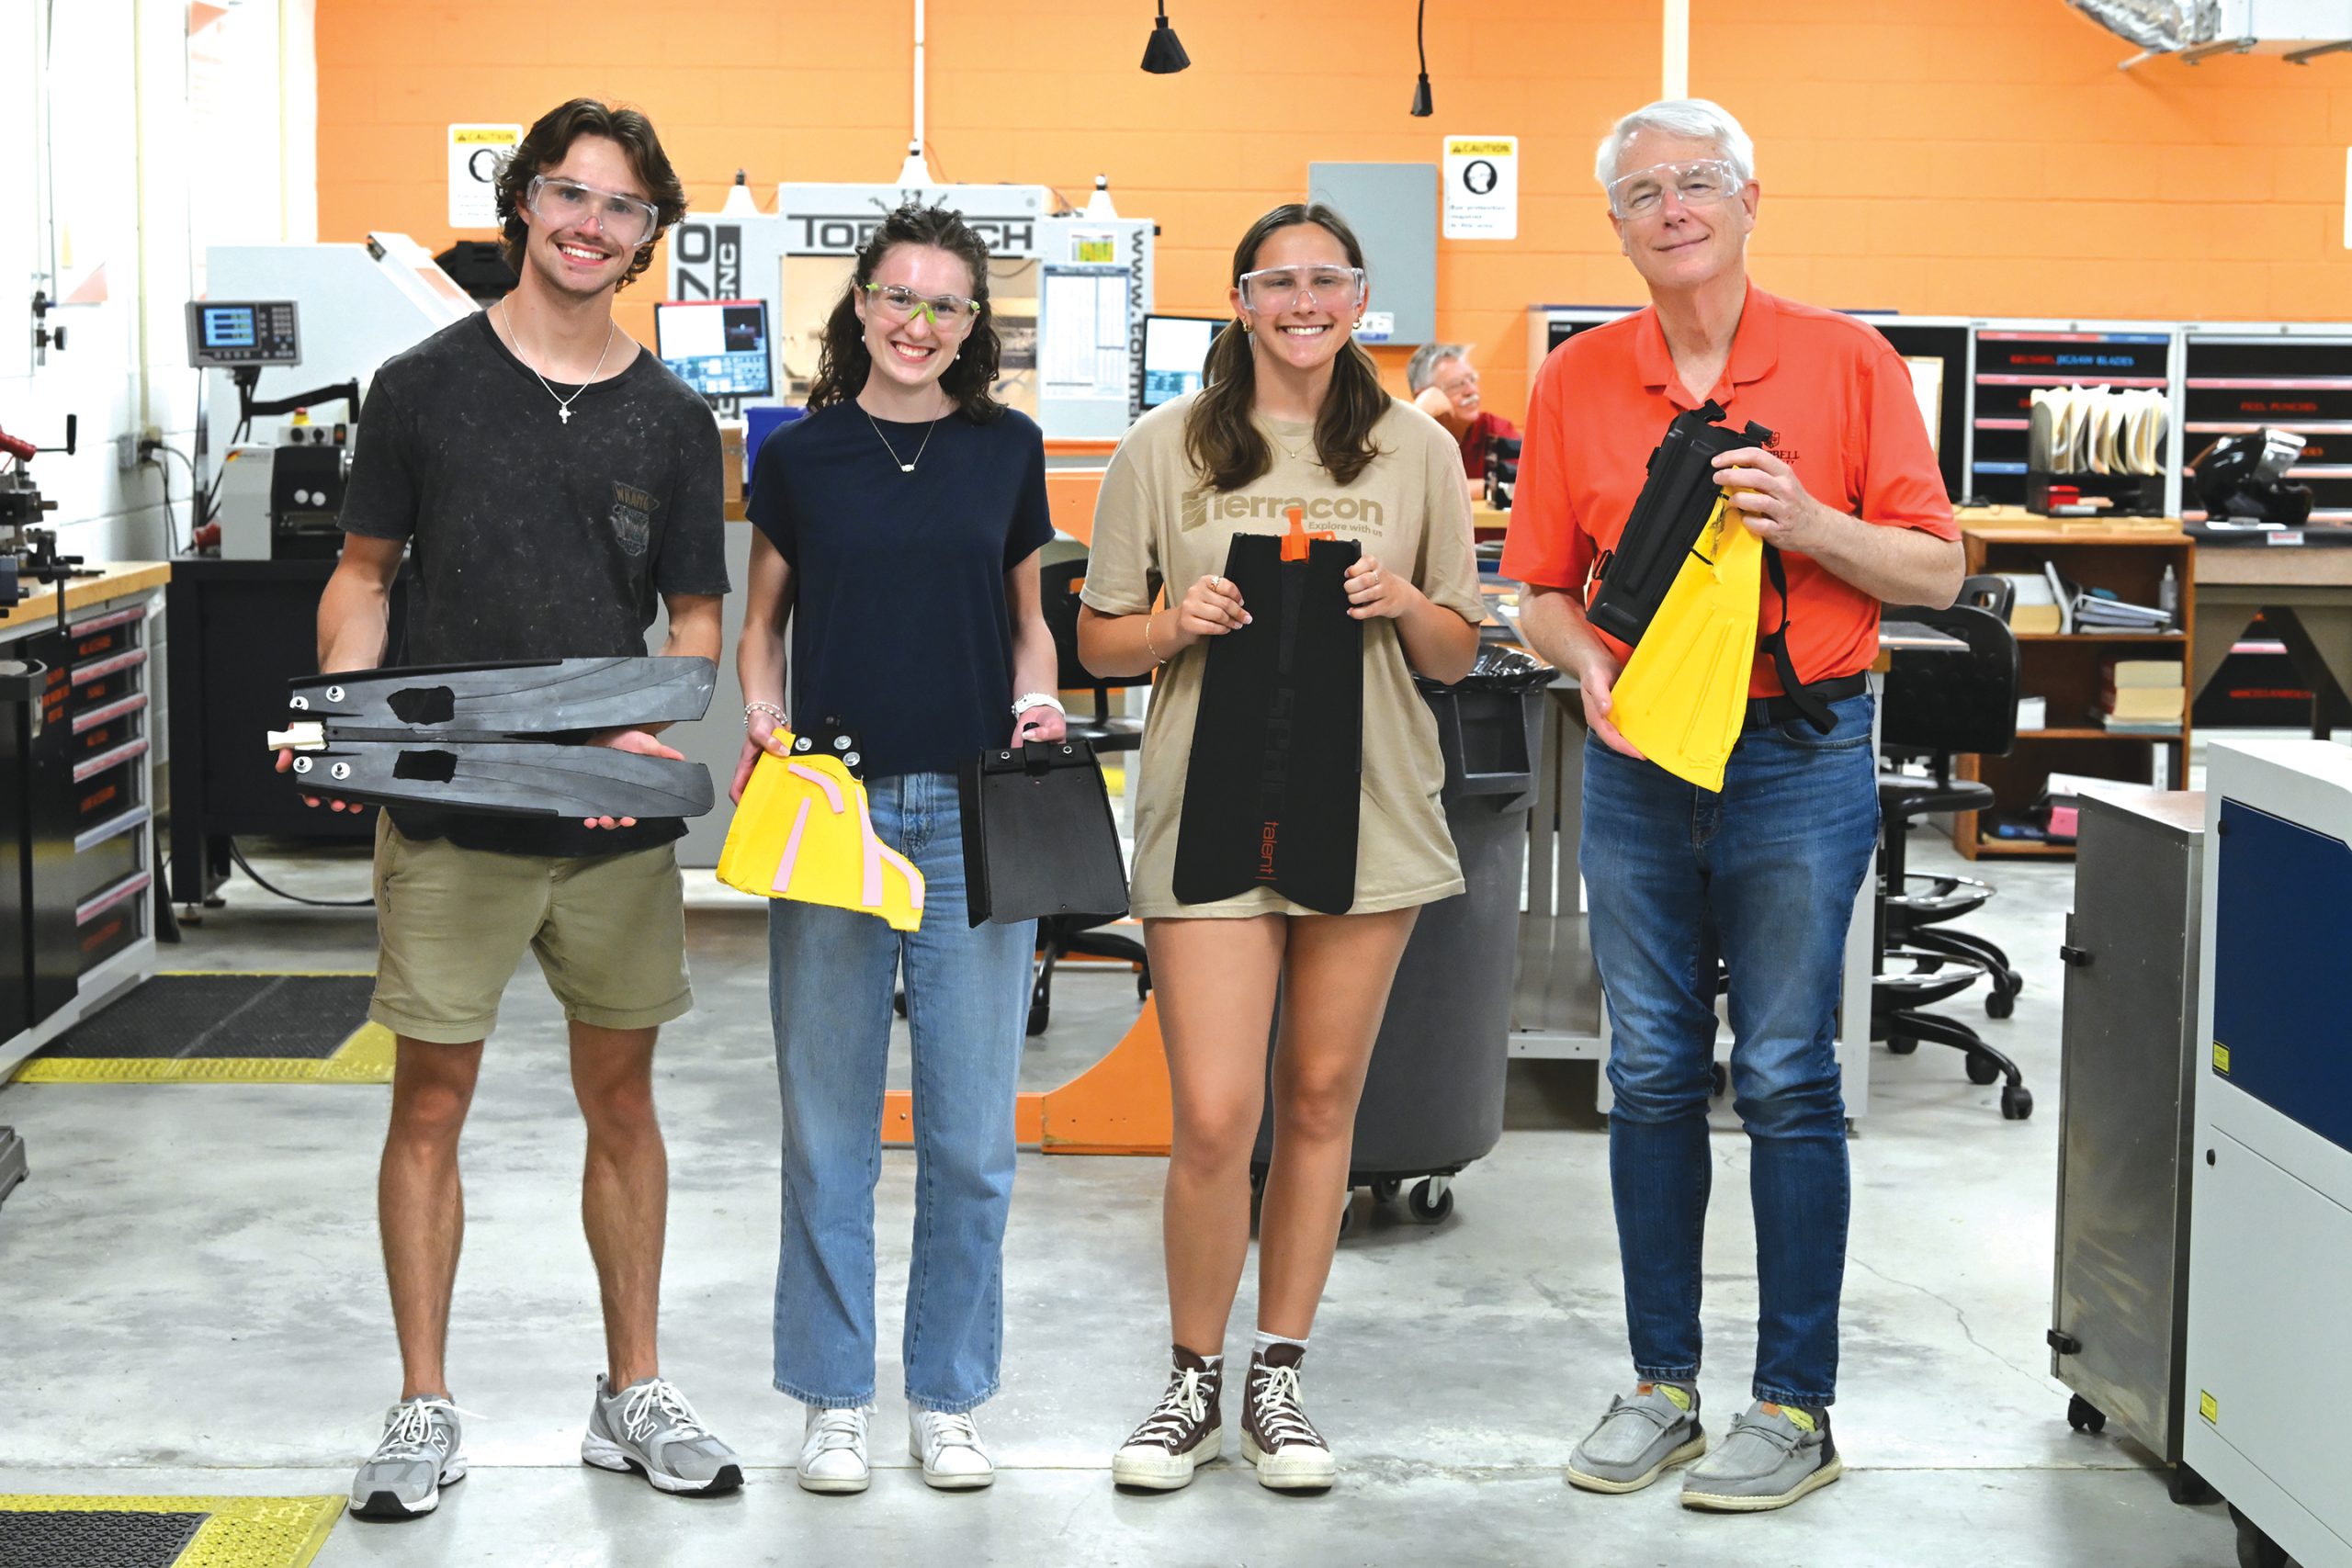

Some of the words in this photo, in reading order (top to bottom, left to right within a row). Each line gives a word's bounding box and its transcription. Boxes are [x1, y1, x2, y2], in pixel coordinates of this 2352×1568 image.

[1768, 450, 1800, 459] BELL
[1202, 490, 1384, 526] Terracon
[1308, 521, 1347, 531] Explore
[1350, 524, 1371, 534] with
[1373, 528, 1383, 537] us
[1260, 821, 1279, 874] talent
